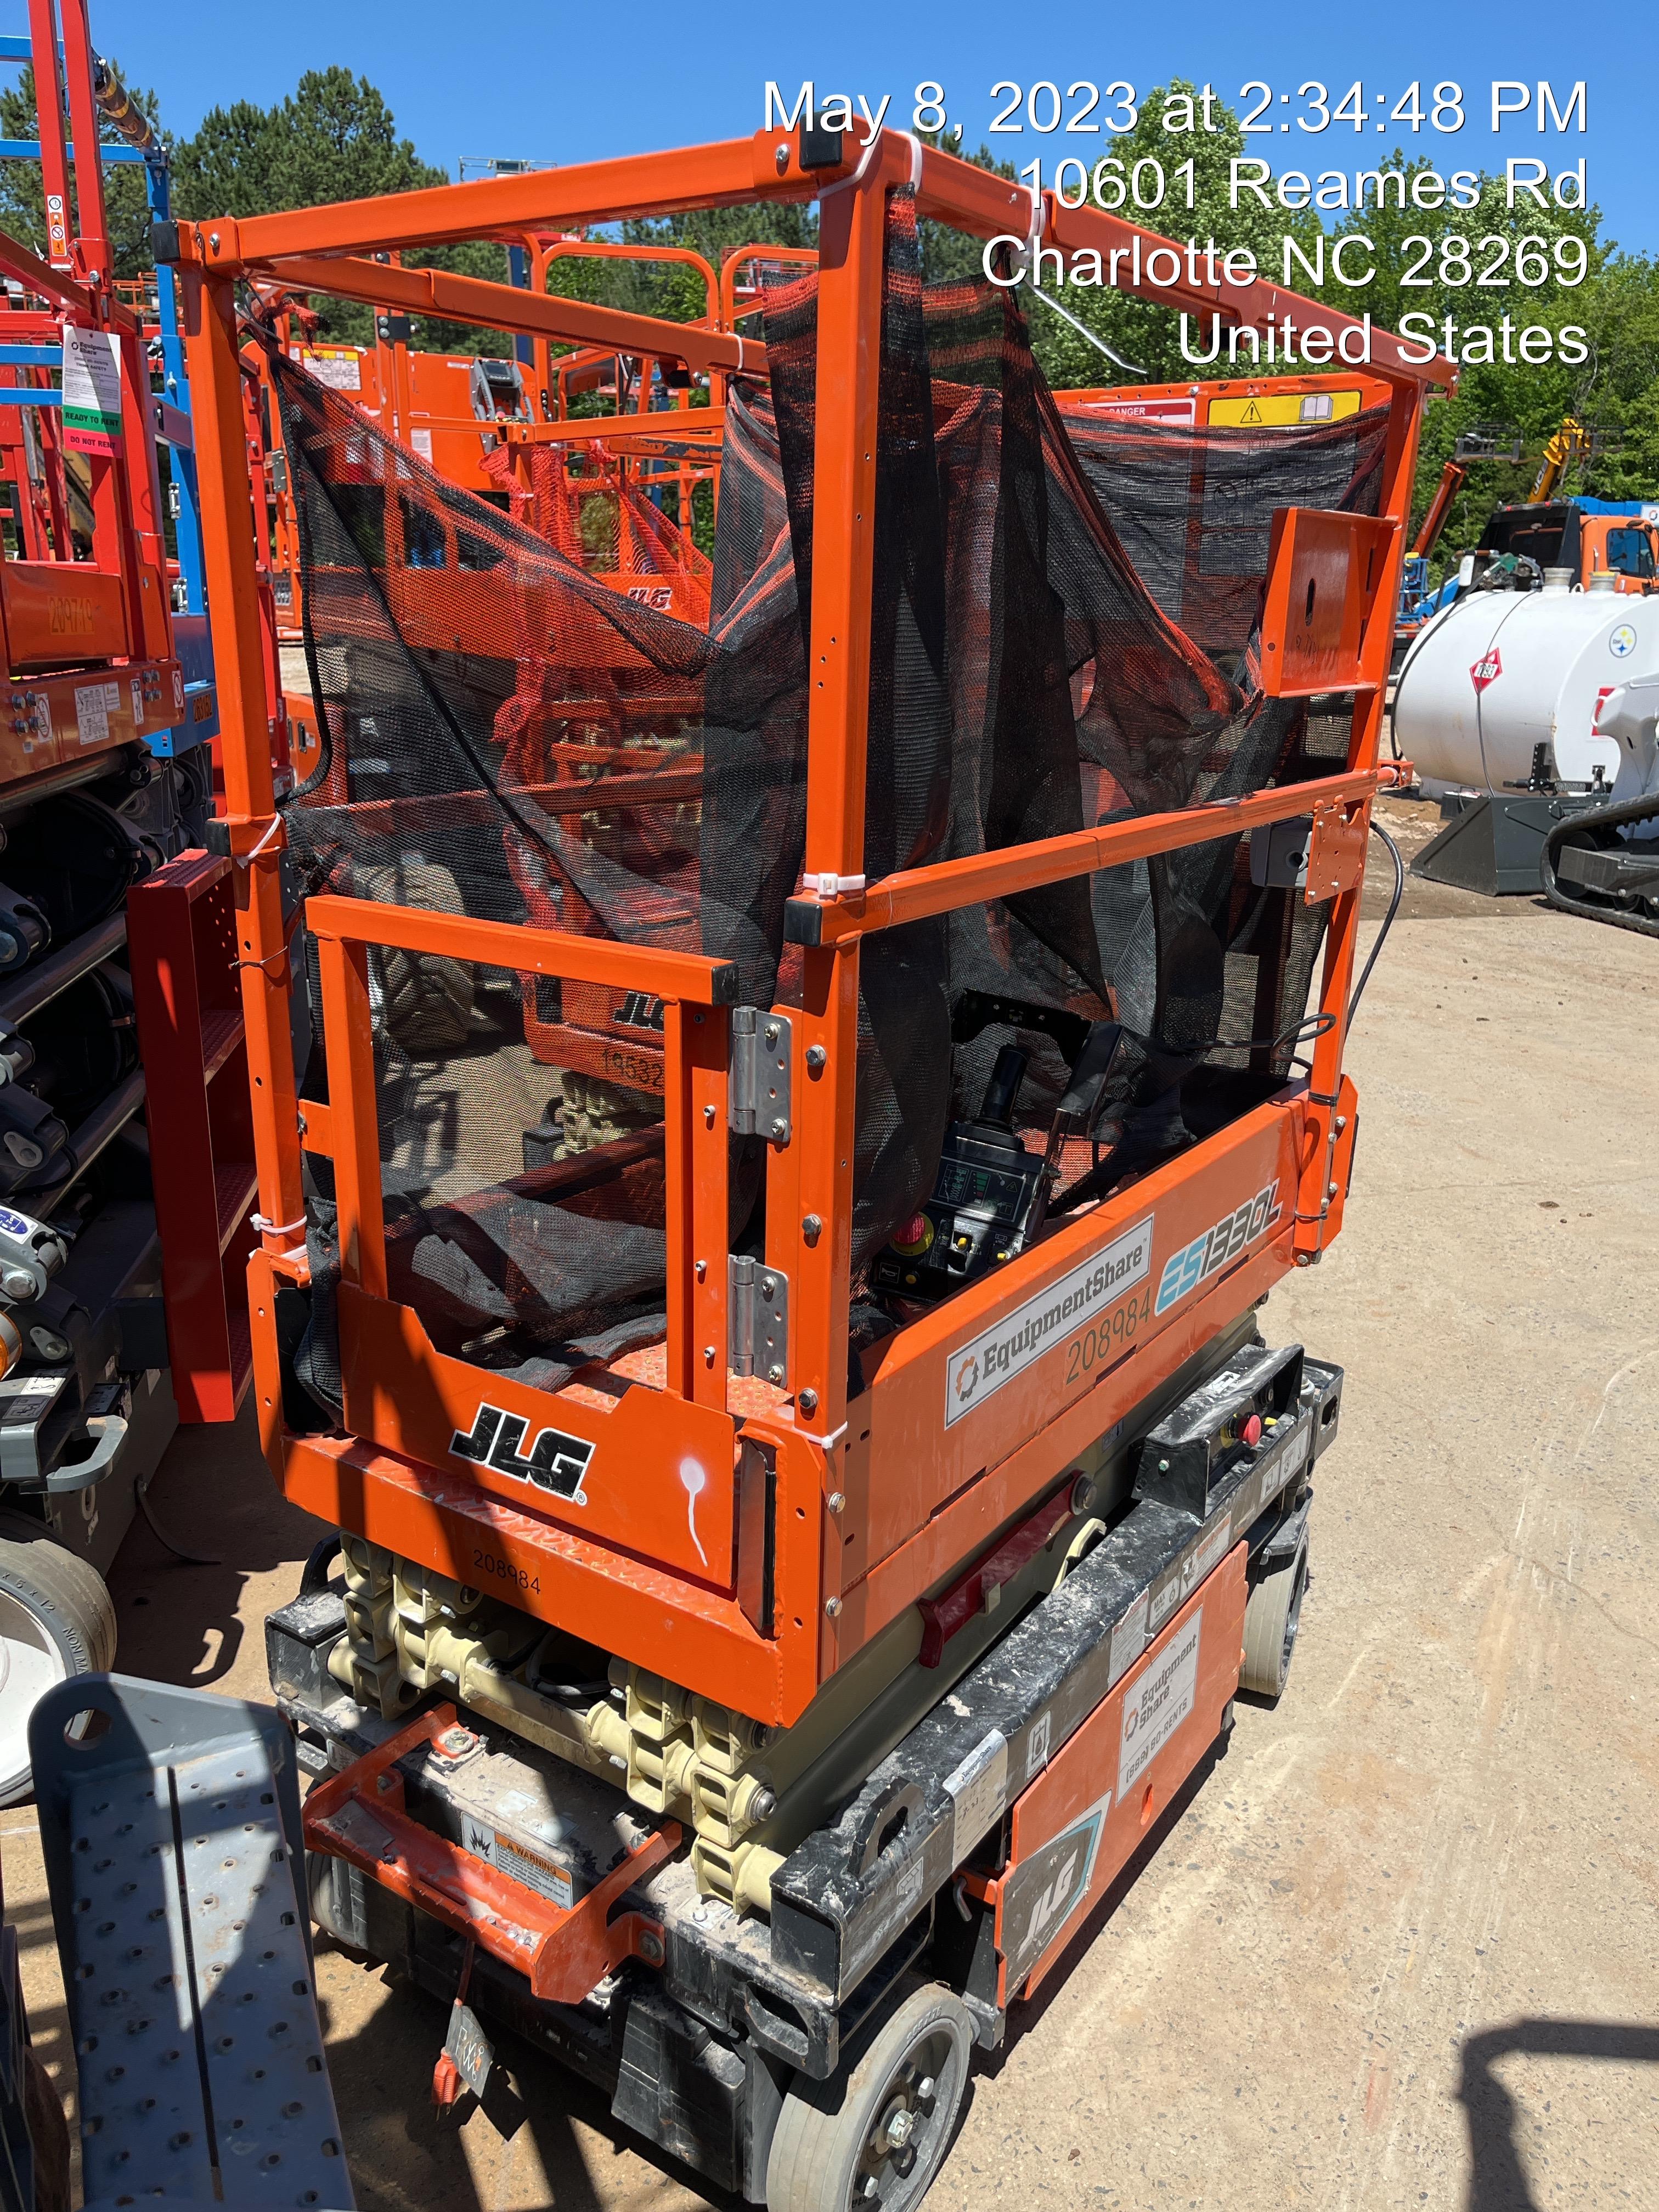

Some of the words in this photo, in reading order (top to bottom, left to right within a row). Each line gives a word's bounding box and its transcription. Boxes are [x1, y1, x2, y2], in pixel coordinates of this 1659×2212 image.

[65, 412, 88, 423] READY
[89, 415, 98, 425] TO
[100, 416, 119, 427] RENT
[70, 436, 80, 444] DO
[82, 438, 95, 447] NOT
[98, 439, 116, 449] RENT
[1154, 1177, 1283, 1317] ES1330L
[983, 1243, 1143, 1380] EquipmentShare
[1065, 1285, 1151, 1386] 208984
[448, 1401, 596, 1503] JLG
[473, 1549, 541, 1594] 208984
[61, 1626, 84, 1655] NON
[1141, 1633, 1197, 1711] Equipment
[1139, 1684, 1170, 1730] Share
[516, 1845, 556, 1875] WARNING
[1016, 1848, 1079, 1961] JLG
